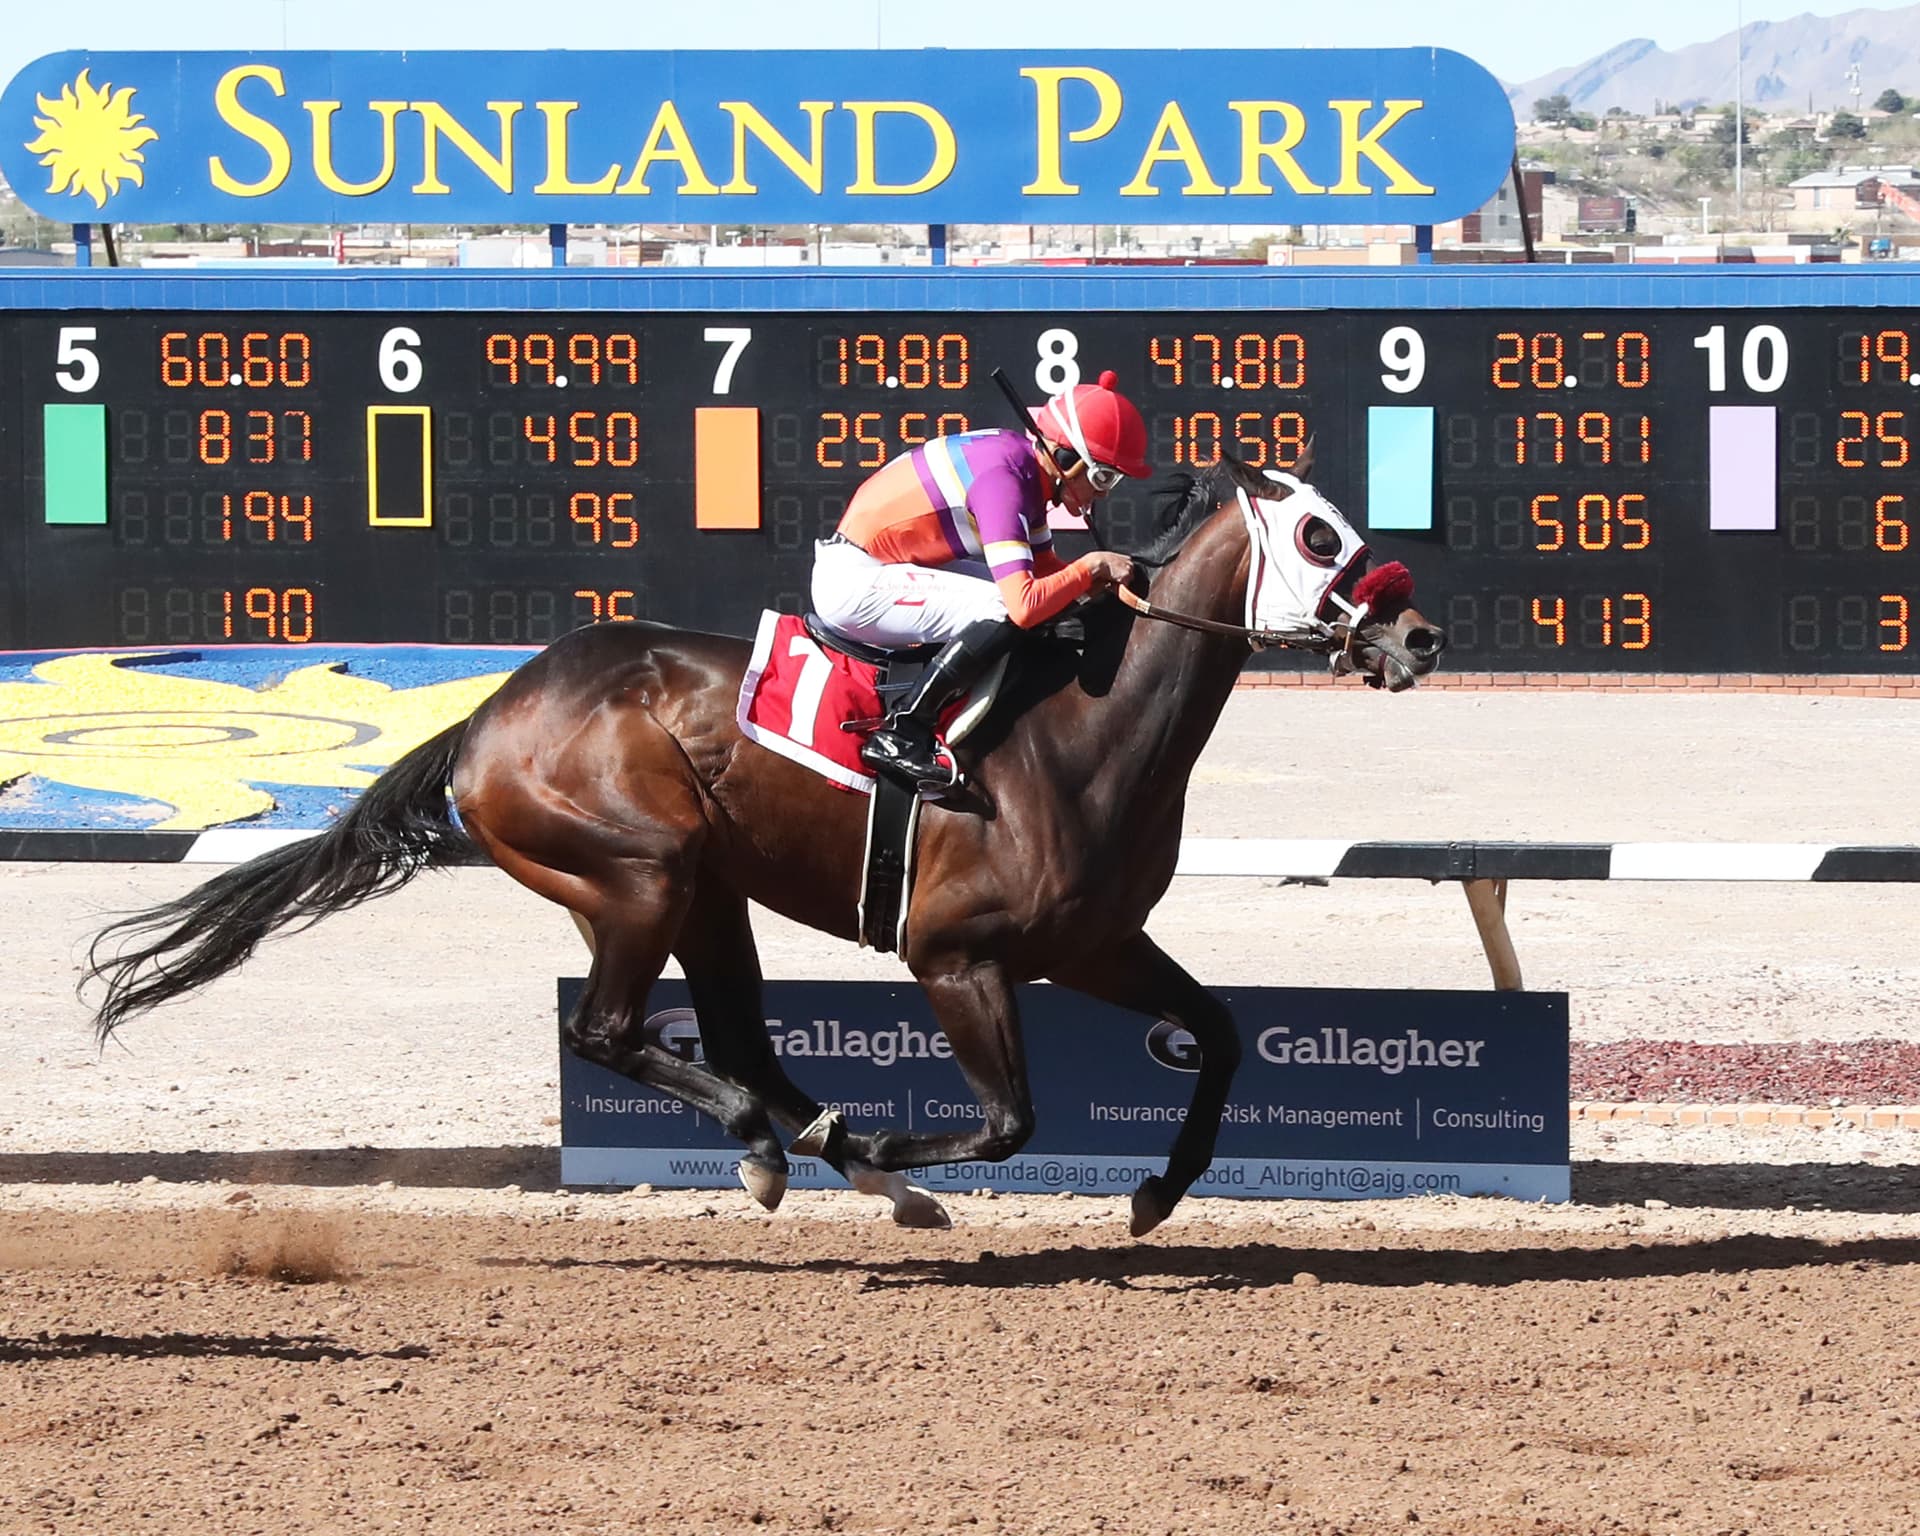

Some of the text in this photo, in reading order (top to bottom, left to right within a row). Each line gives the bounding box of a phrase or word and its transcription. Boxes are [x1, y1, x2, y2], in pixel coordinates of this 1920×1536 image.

[208, 63, 1436, 199] SUNLAND PARK
[55, 327, 100, 393] 5
[161, 331, 312, 388] 60.60
[378, 326, 423, 393] 6
[485, 333, 639, 388] 99.99
[703, 327, 752, 394] 7
[838, 333, 969, 390] 19.80
[1035, 328, 1081, 396] 8
[1149, 333, 1306, 390] 47.80
[1379, 326, 1426, 394] 9
[1693, 324, 1789, 393] 10
[1836, 411, 1909, 468] 25
[222, 490, 313, 543] 194
[569, 492, 639, 548] 95
[1531, 493, 1651, 551] 505
[1875, 495, 1909, 552] 6
[223, 587, 313, 643] 190
[1879, 594, 1909, 652] 3
[764, 1018, 953, 1067] allaghe
[1256, 1025, 1486, 1075] Gallagher
[585, 1094, 683, 1114] Insurance
[1090, 1101, 1545, 1133] Insurance Risk Management Consulting
[1197, 1164, 1461, 1193] odd_Albright@ajg.com
